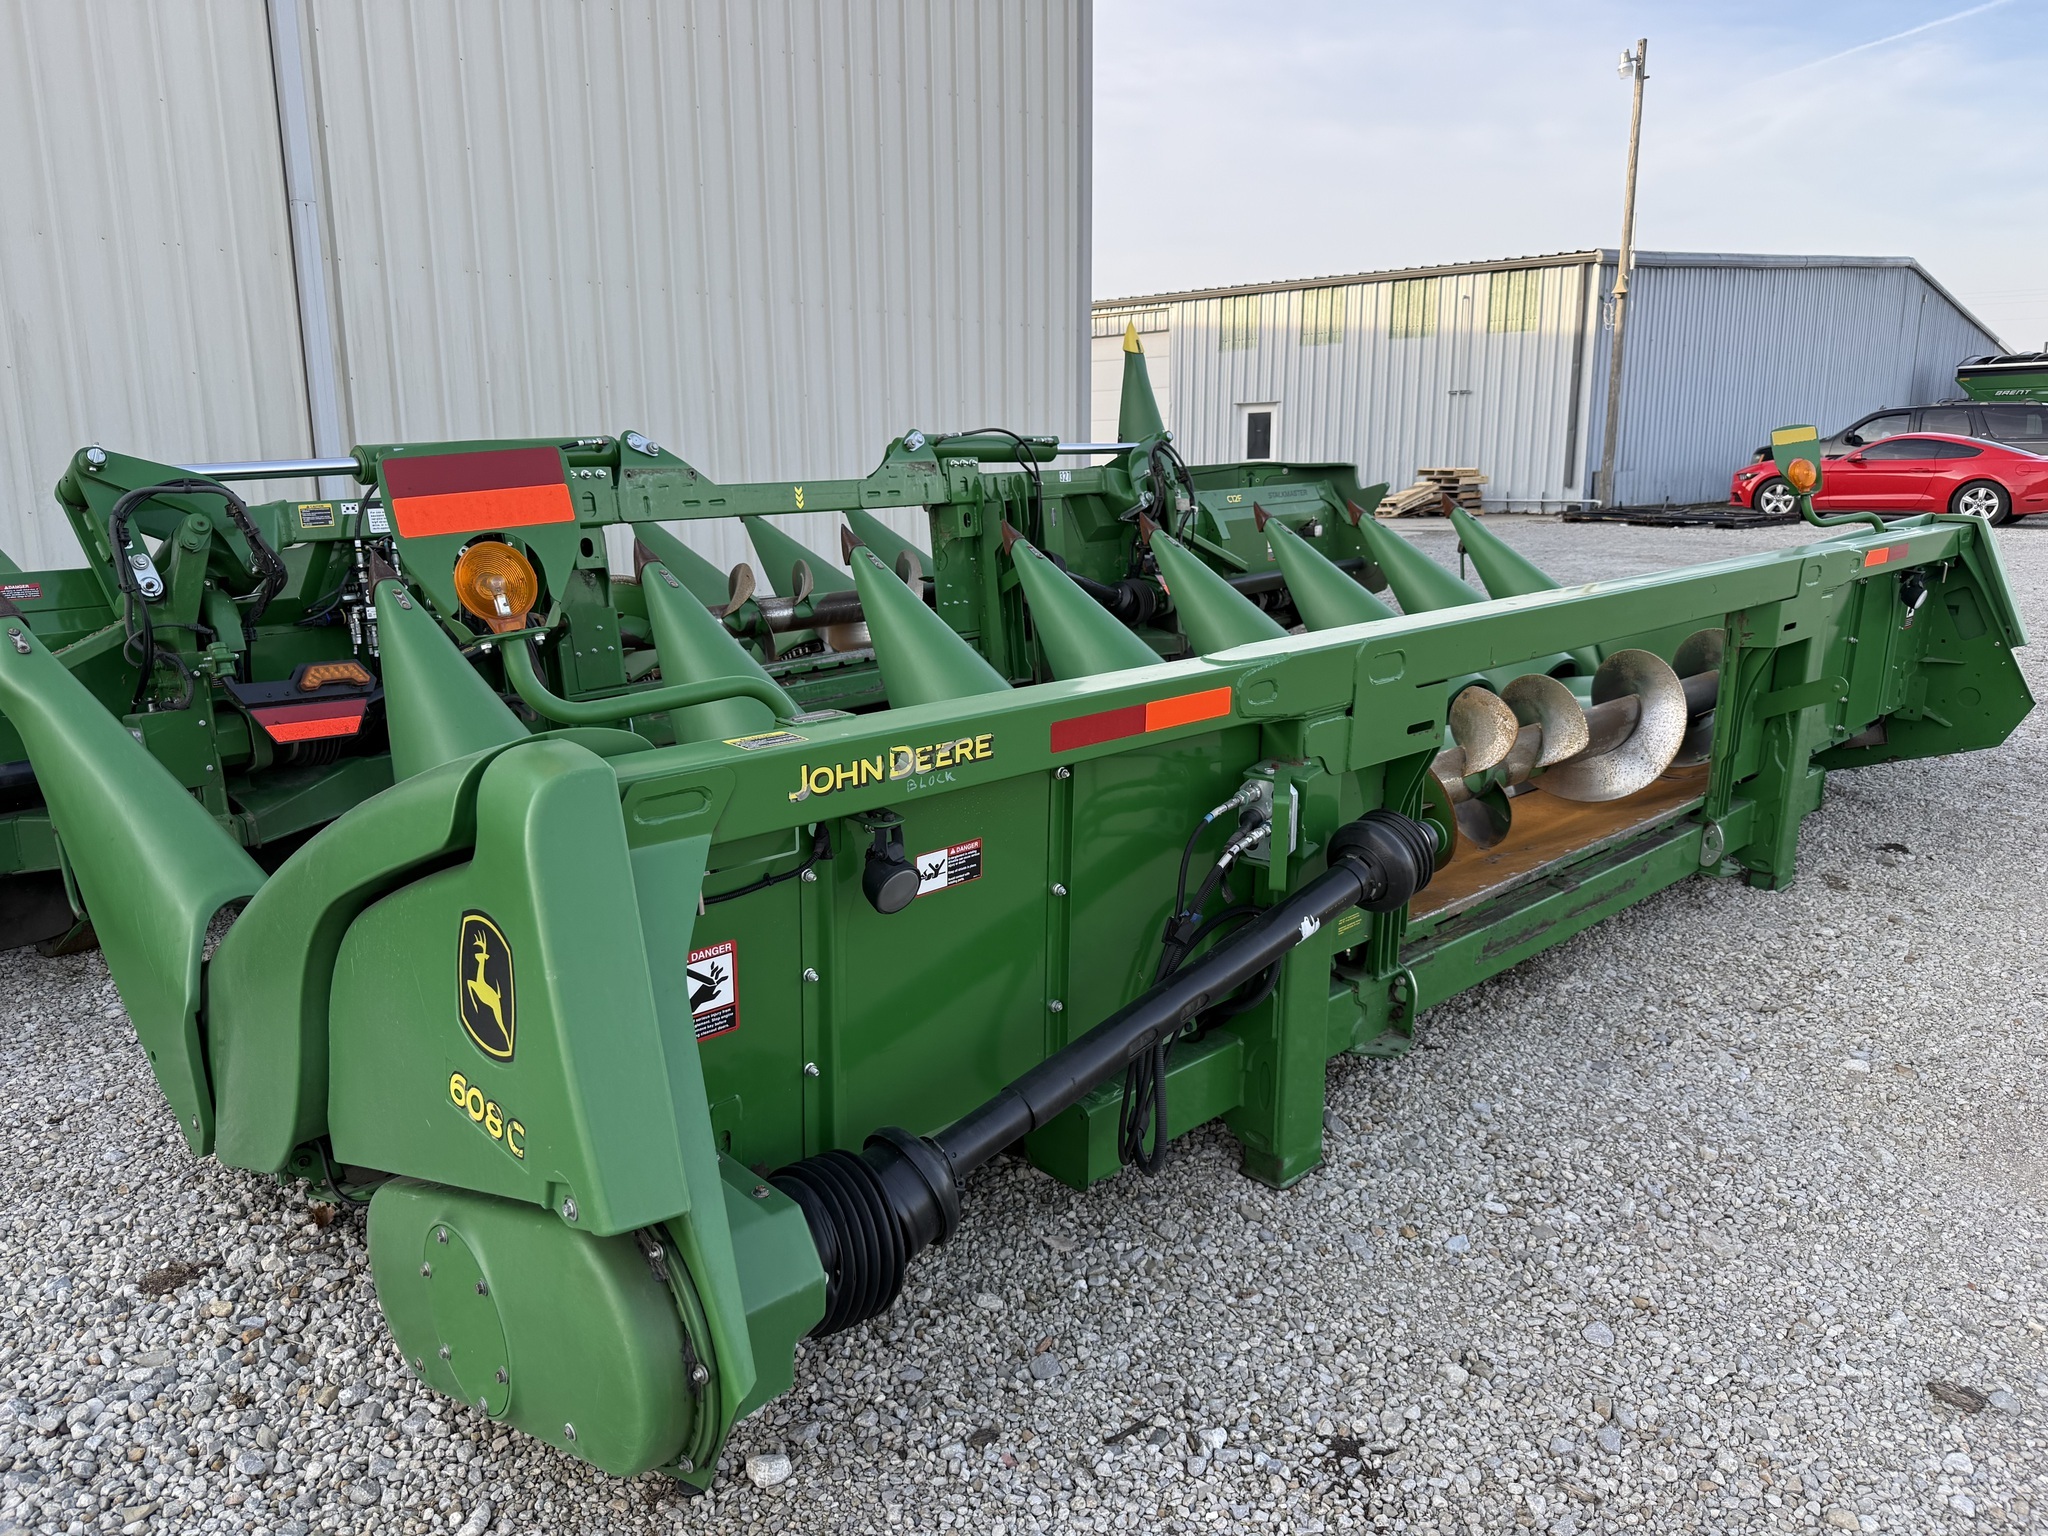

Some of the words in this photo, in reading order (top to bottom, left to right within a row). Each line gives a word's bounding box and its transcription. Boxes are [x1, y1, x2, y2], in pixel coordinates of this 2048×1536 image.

[1267, 489, 1308, 499] STALKMASTER
[787, 754, 885, 803] JOHN
[889, 732, 994, 780] DEERE
[906, 771, 956, 792] BLOCK
[956, 841, 979, 853] DANGER
[691, 942, 732, 962] DANGER
[449, 1070, 526, 1160] 608C
